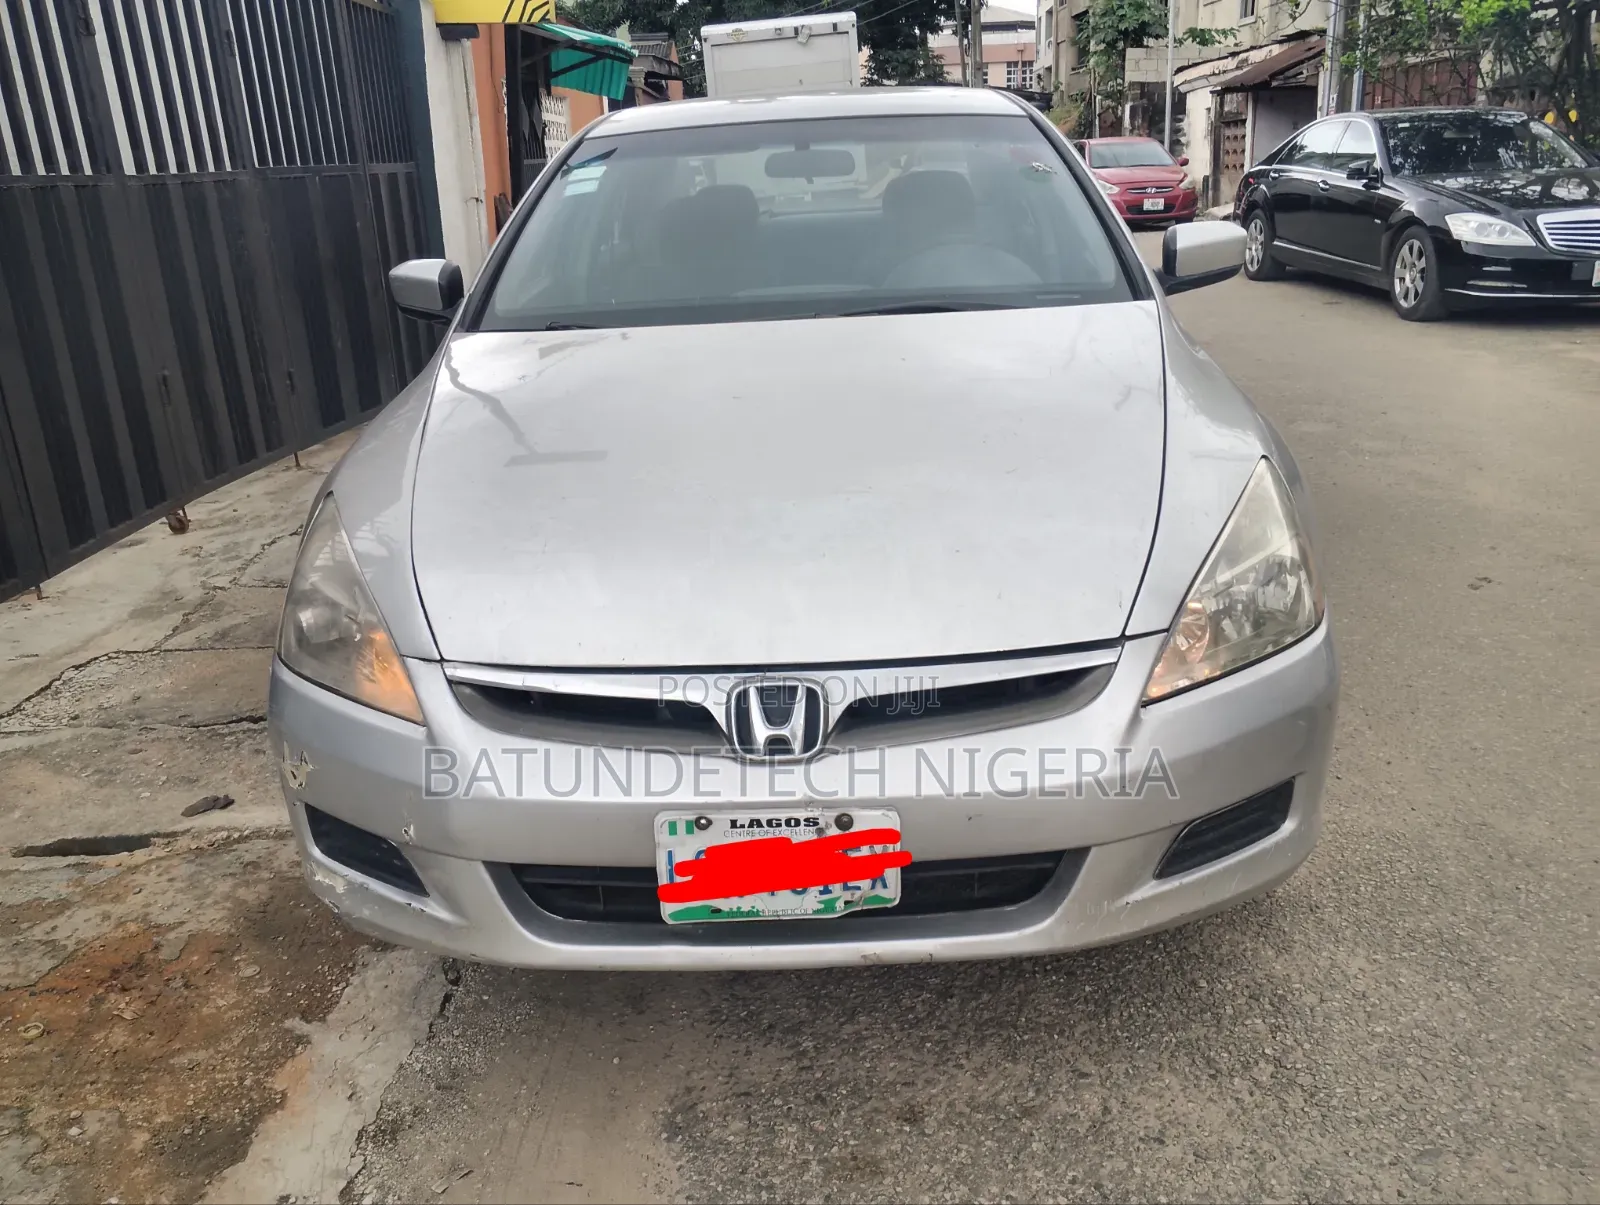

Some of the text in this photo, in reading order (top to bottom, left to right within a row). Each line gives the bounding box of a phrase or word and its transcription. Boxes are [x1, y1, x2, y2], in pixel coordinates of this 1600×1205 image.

[730, 817, 820, 829] LAGOS
[724, 828, 825, 838] CENTRE OF EXCELLEN
